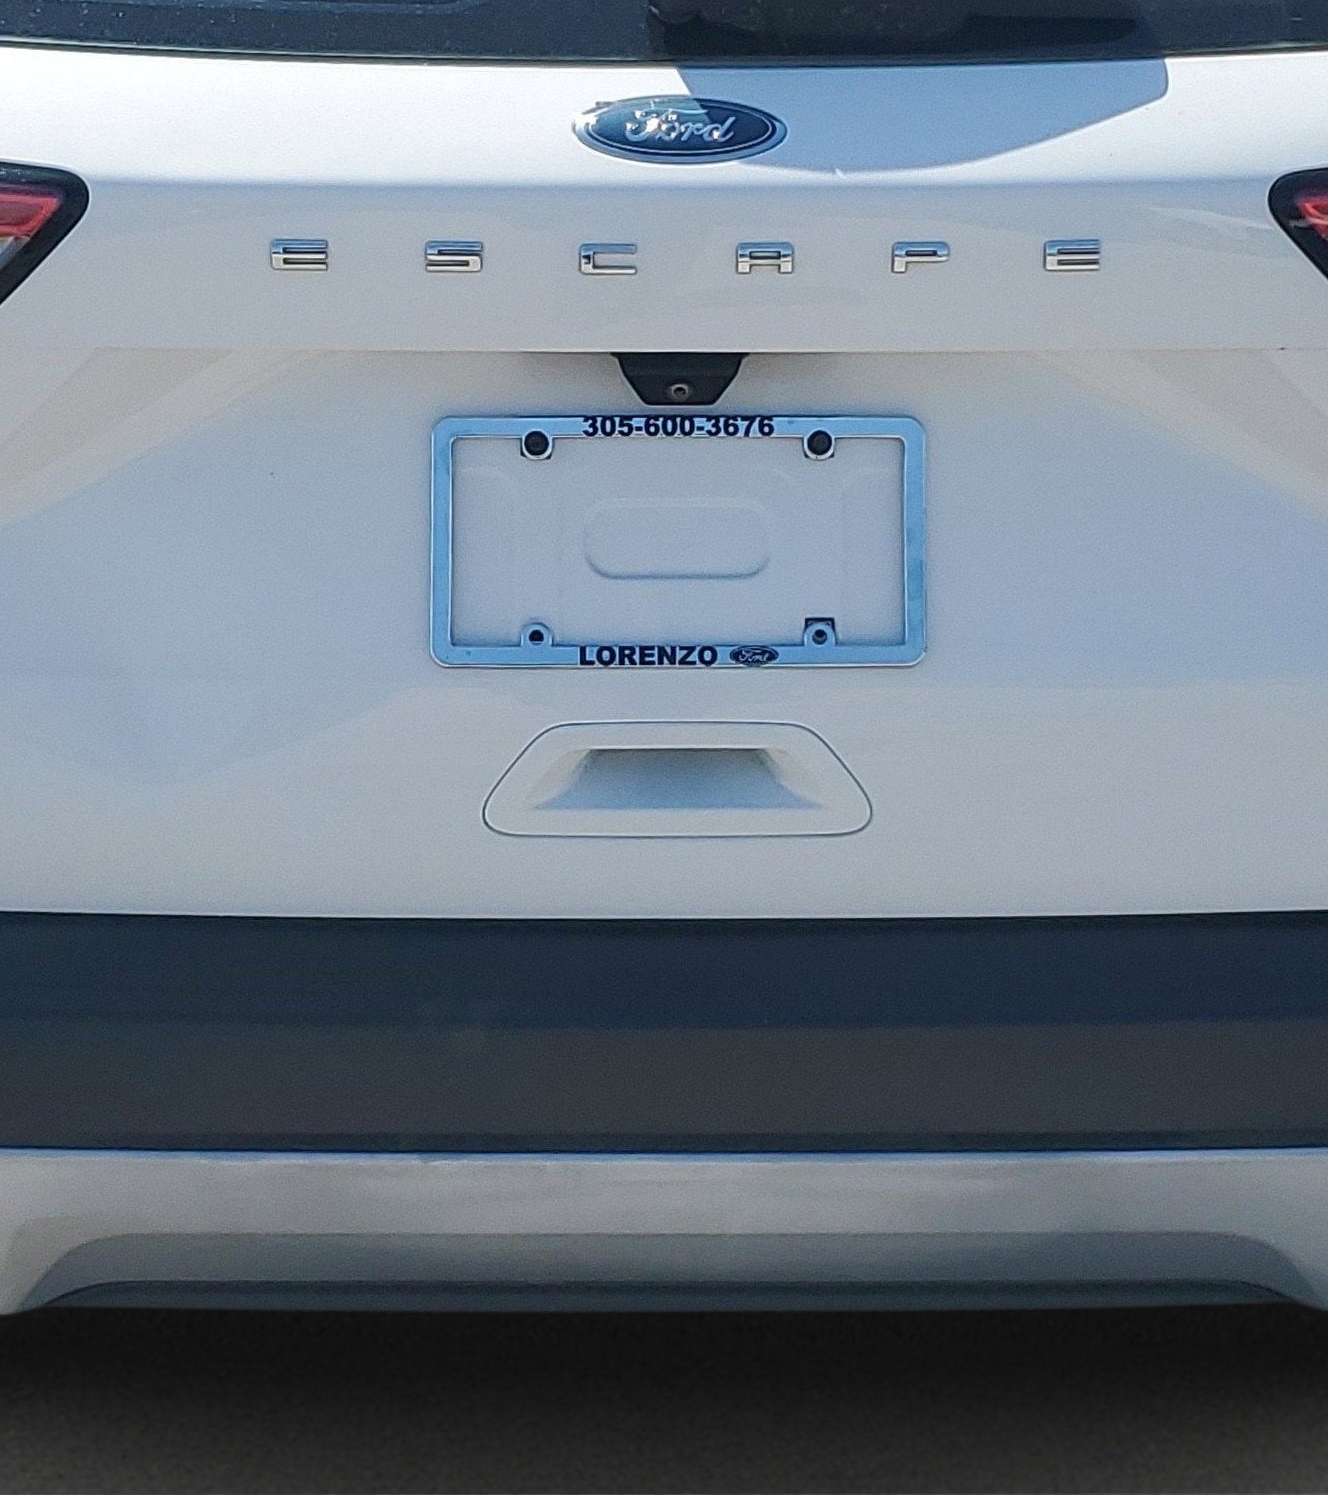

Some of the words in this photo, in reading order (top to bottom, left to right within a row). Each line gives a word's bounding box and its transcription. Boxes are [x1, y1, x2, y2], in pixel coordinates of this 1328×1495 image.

[625, 106, 736, 143] Ford
[270, 238, 1102, 274] ESCAPE
[582, 415, 775, 437] 305-600-3676
[579, 645, 718, 667] LORENZO
